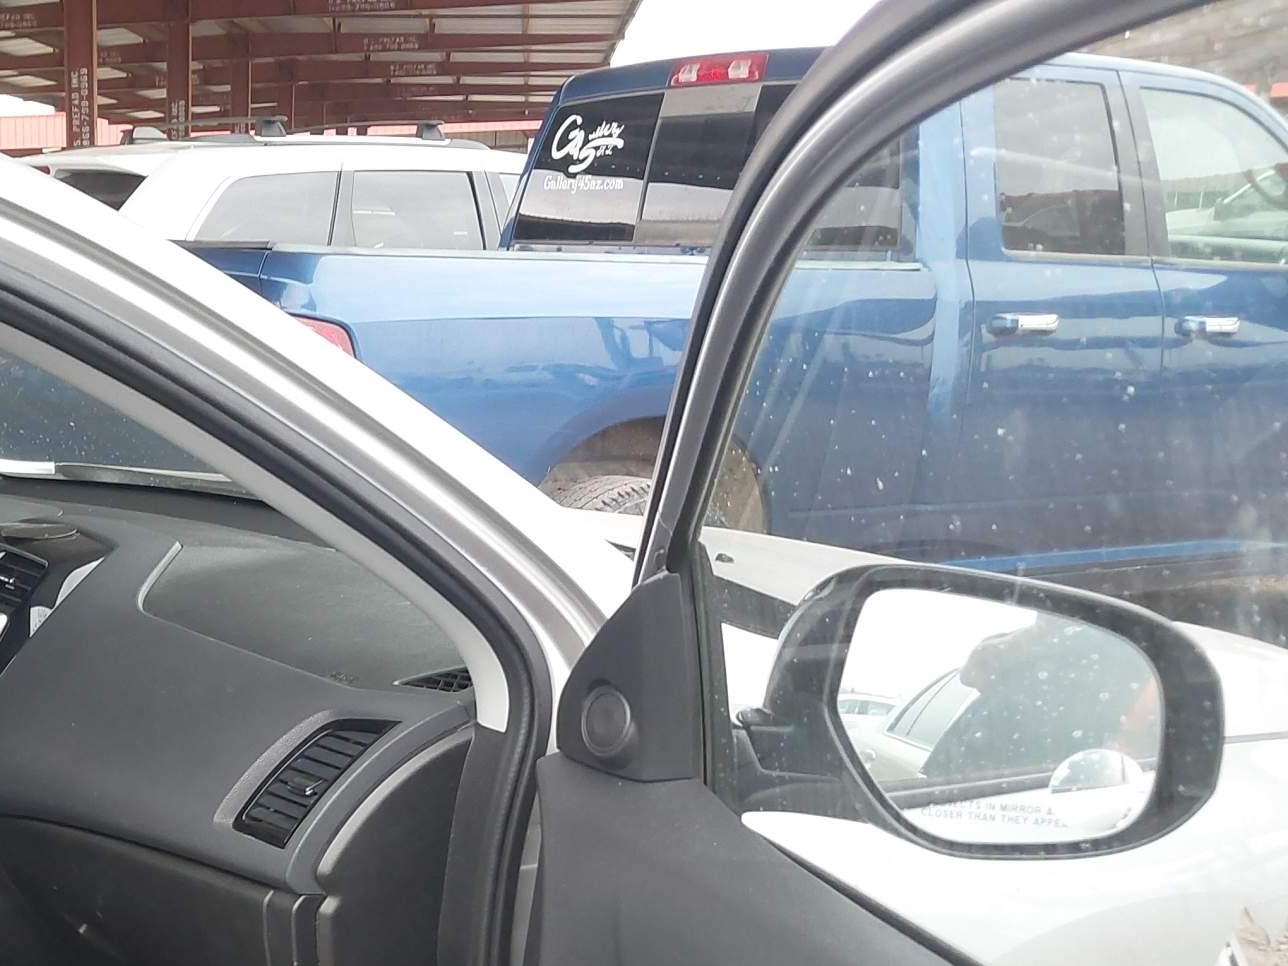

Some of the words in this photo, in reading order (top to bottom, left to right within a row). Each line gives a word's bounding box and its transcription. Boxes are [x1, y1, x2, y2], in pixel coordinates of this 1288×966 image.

[71, 91, 81, 132] PREFAB
[920, 807, 963, 819] CLOSER
[967, 812, 997, 823] THAN
[1001, 814, 1029, 825] THEY
[1000, 803, 1042, 814] MIRROR
